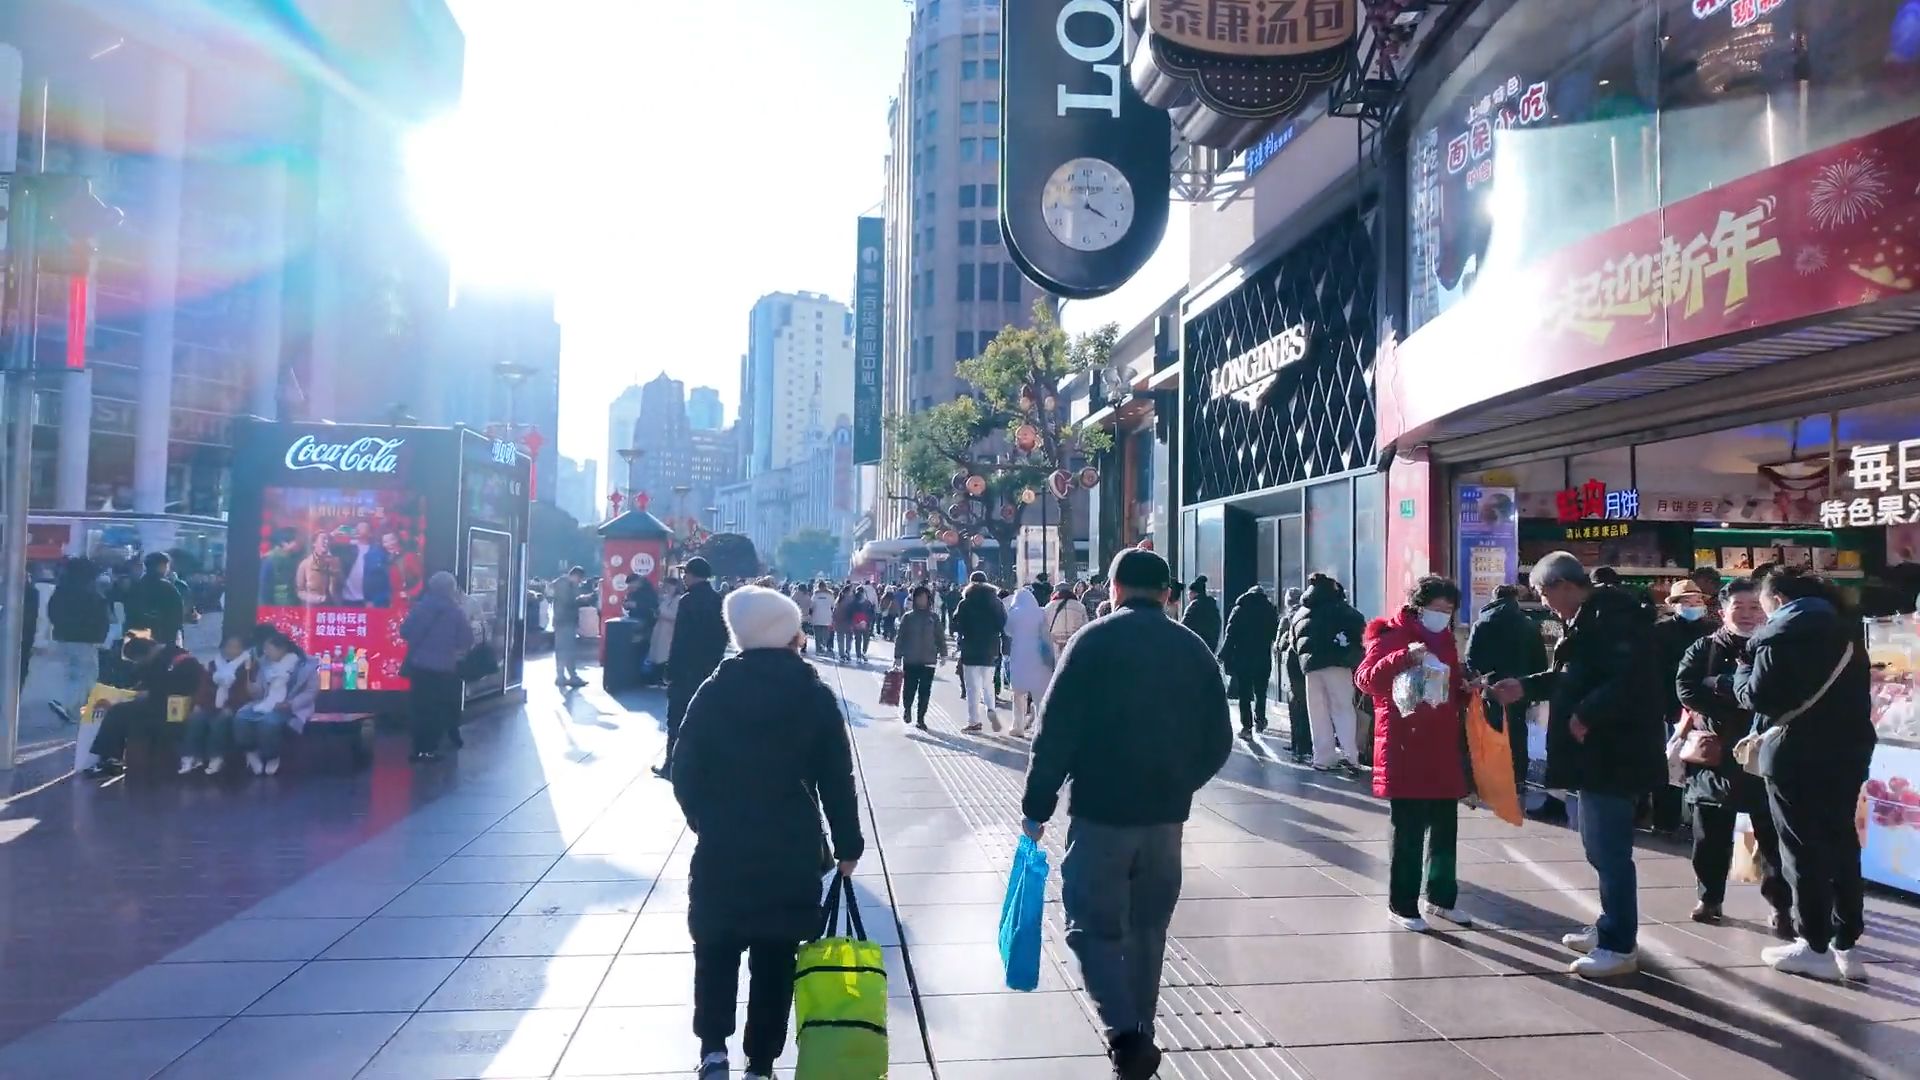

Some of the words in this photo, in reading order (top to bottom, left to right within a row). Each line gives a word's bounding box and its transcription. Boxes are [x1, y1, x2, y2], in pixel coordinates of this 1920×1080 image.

[1159, 0, 1344, 44] 泰康汤包
[1731, 0, 1786, 28] 现
[1210, 322, 1308, 401] LONGINES
[285, 435, 405, 473] Coca-Cola
[1848, 438, 1920, 492] 每日
[1565, 524, 1630, 539] 请认准泰康品牌
[315, 625, 368, 637] 绽放这一刻
